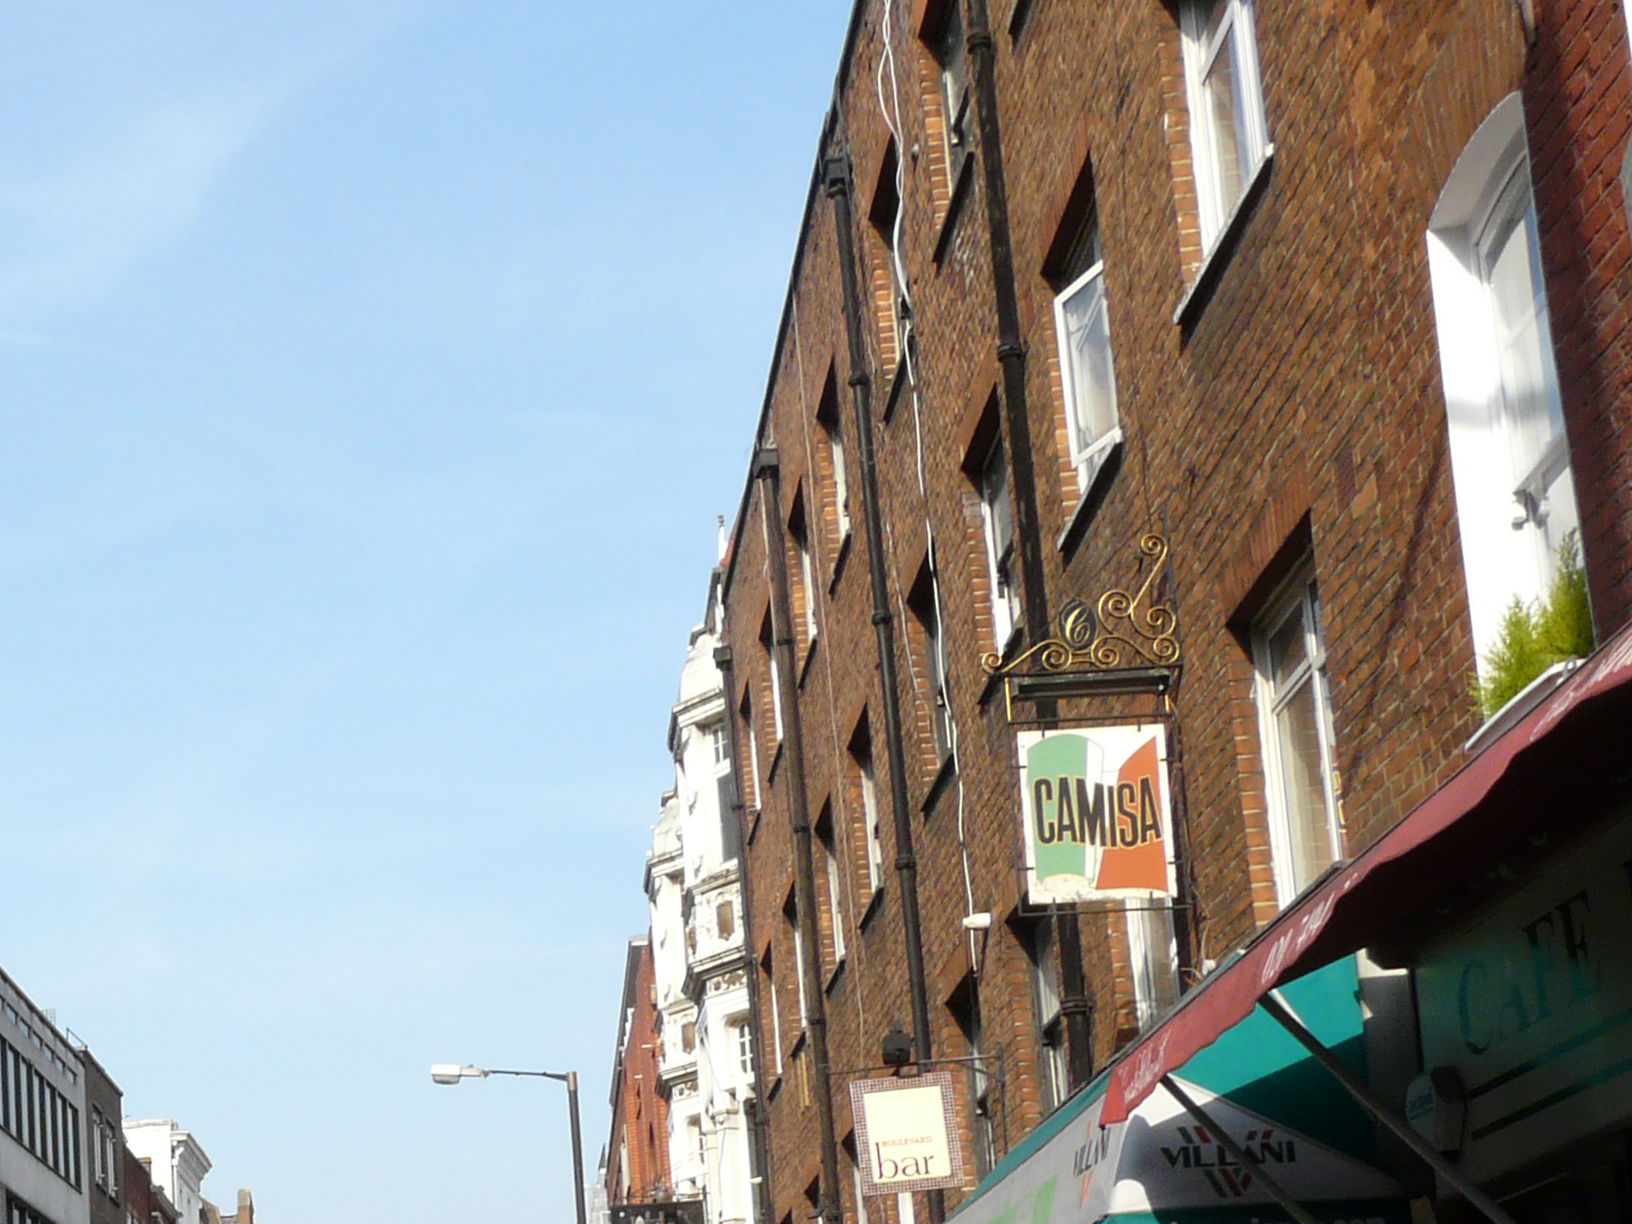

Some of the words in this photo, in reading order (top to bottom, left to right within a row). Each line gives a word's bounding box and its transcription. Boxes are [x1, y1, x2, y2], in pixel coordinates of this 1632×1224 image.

[1033, 775, 1162, 848] CAMISA
[881, 1135, 933, 1148] BOULEVARD
[874, 1142, 935, 1180] bar
